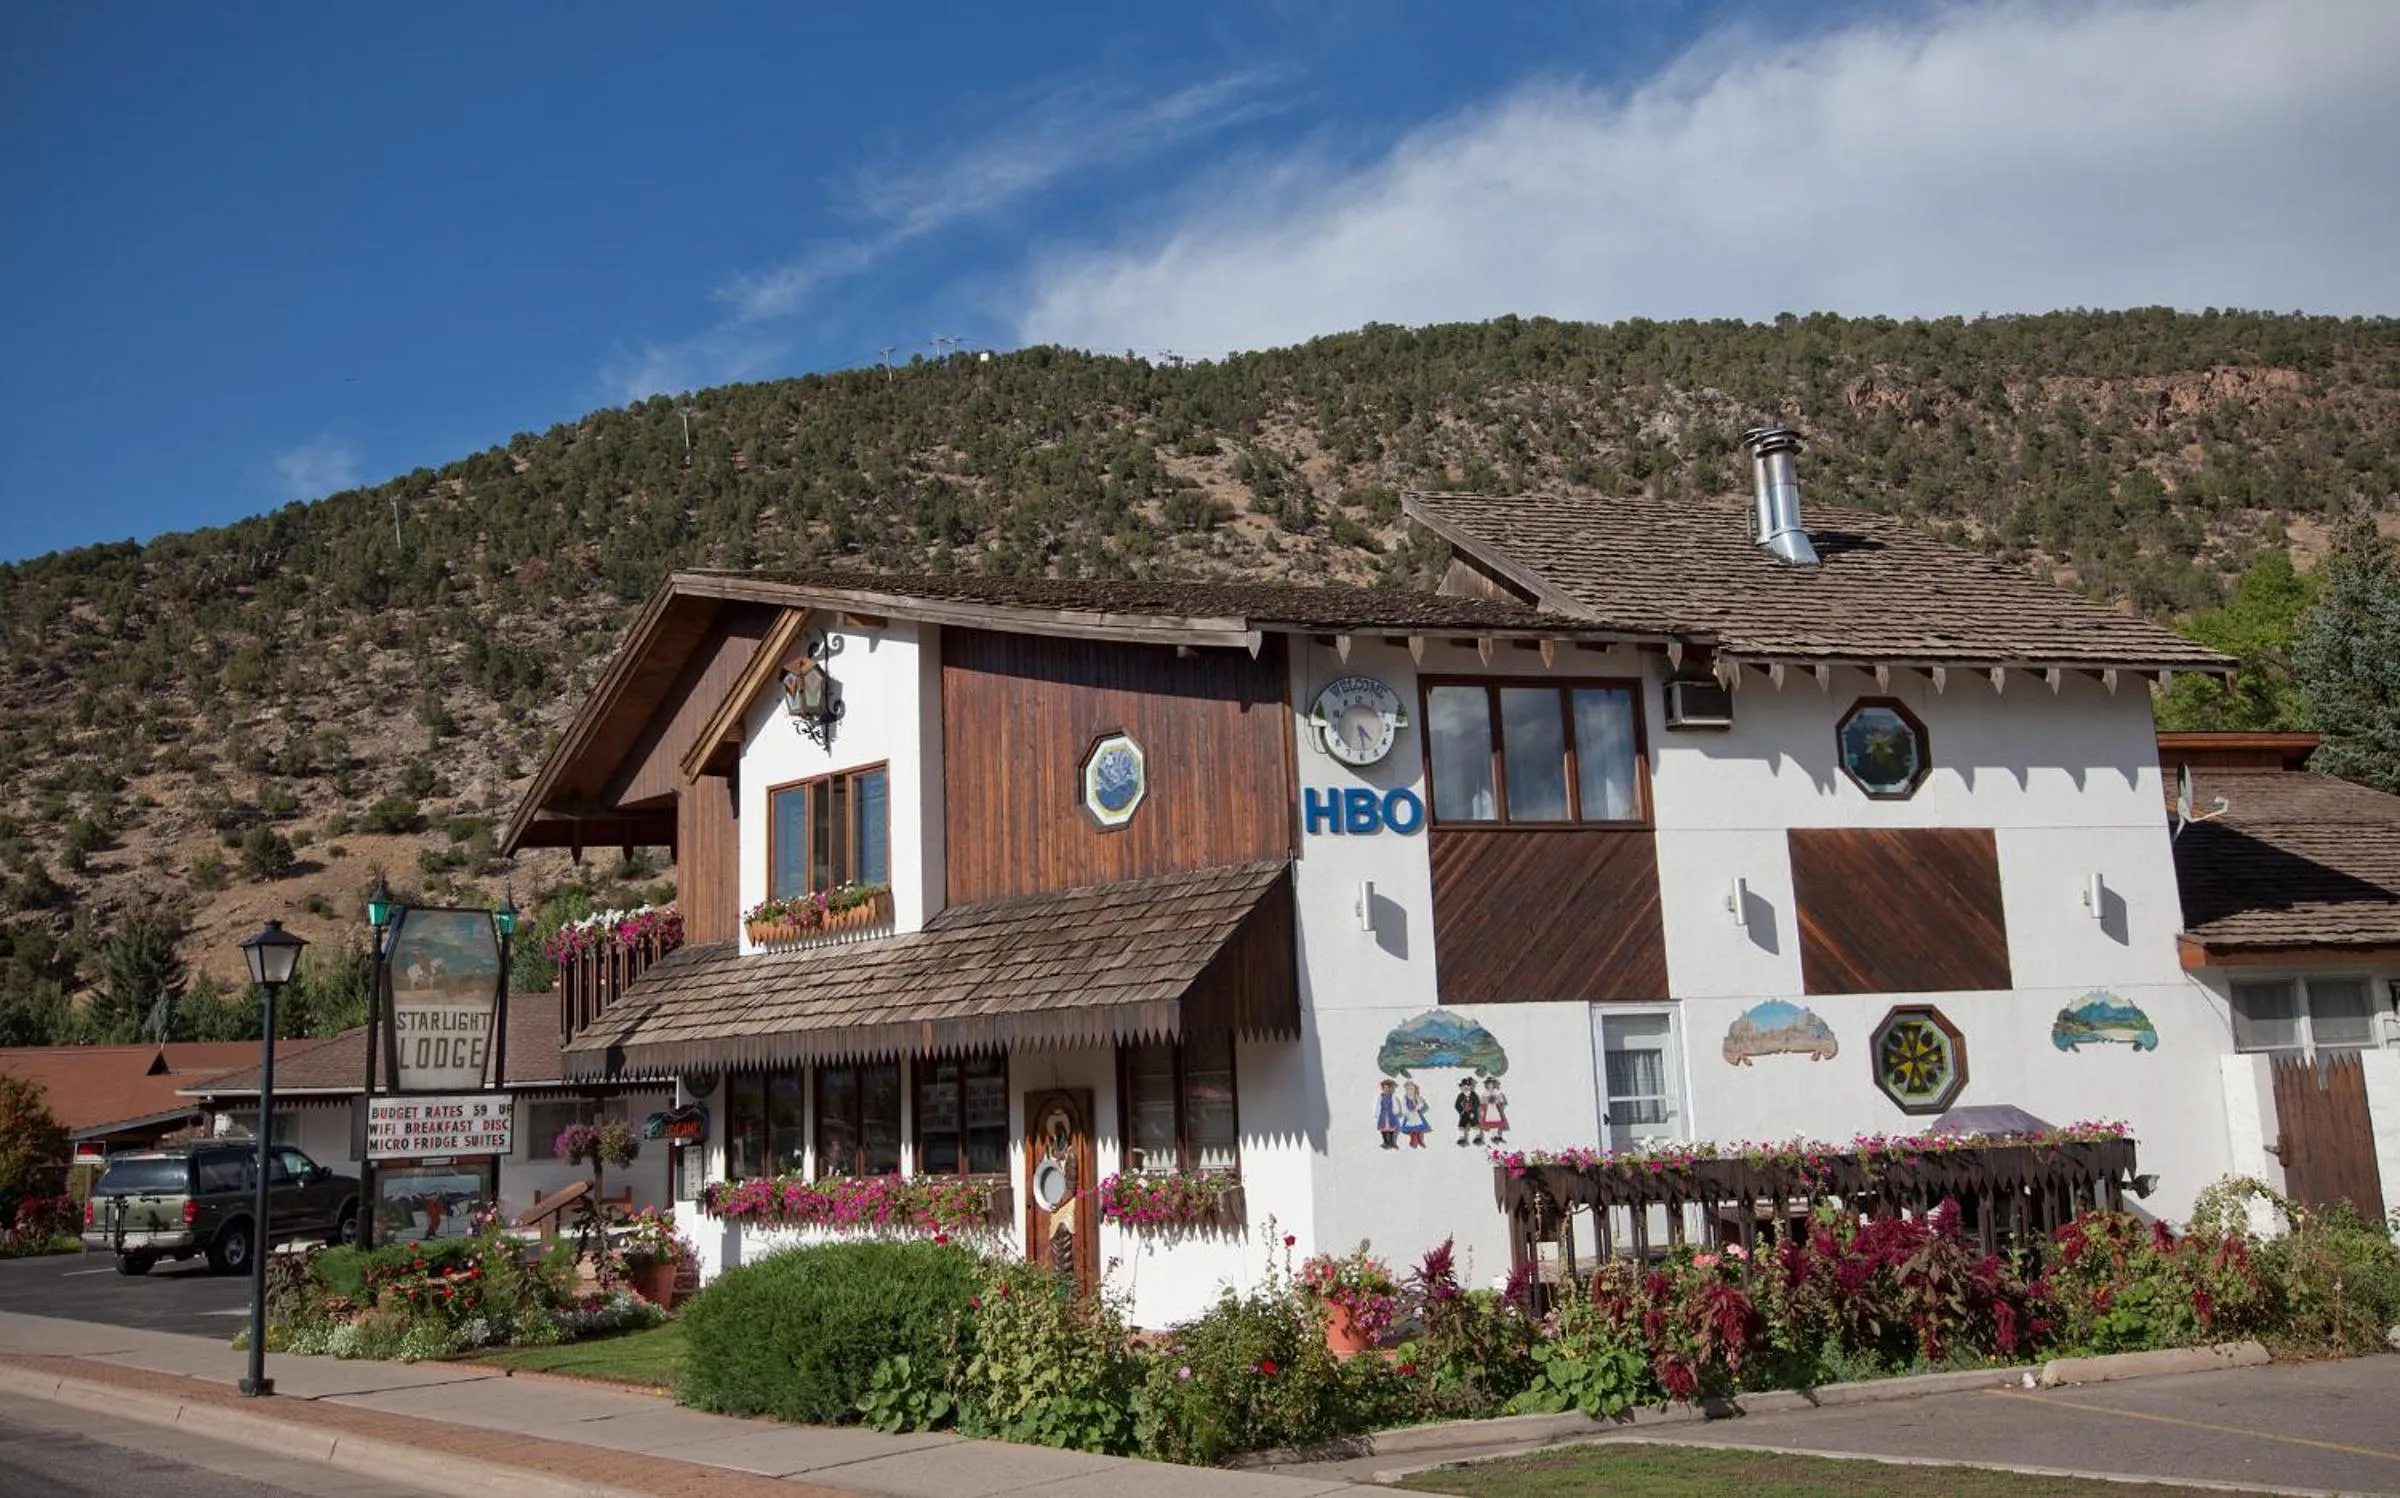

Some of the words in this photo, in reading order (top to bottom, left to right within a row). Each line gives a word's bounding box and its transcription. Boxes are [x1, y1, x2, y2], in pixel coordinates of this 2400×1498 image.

[1329, 679, 1389, 699] WELCOME
[1303, 786, 1425, 834] HBO
[396, 1011, 493, 1031] STARLIGHT
[399, 1037, 484, 1070] LODGE
[372, 1106, 418, 1119] BUDGET
[425, 1104, 463, 1118] RATES
[499, 1103, 513, 1116] UP
[369, 1122, 396, 1136] WIFI
[405, 1120, 472, 1135] BREAKFAST
[483, 1118, 509, 1132] DISC
[369, 1138, 409, 1152] MICRO
[414, 1137, 458, 1151] FRIDGE
[464, 1134, 505, 1147] SUITES
